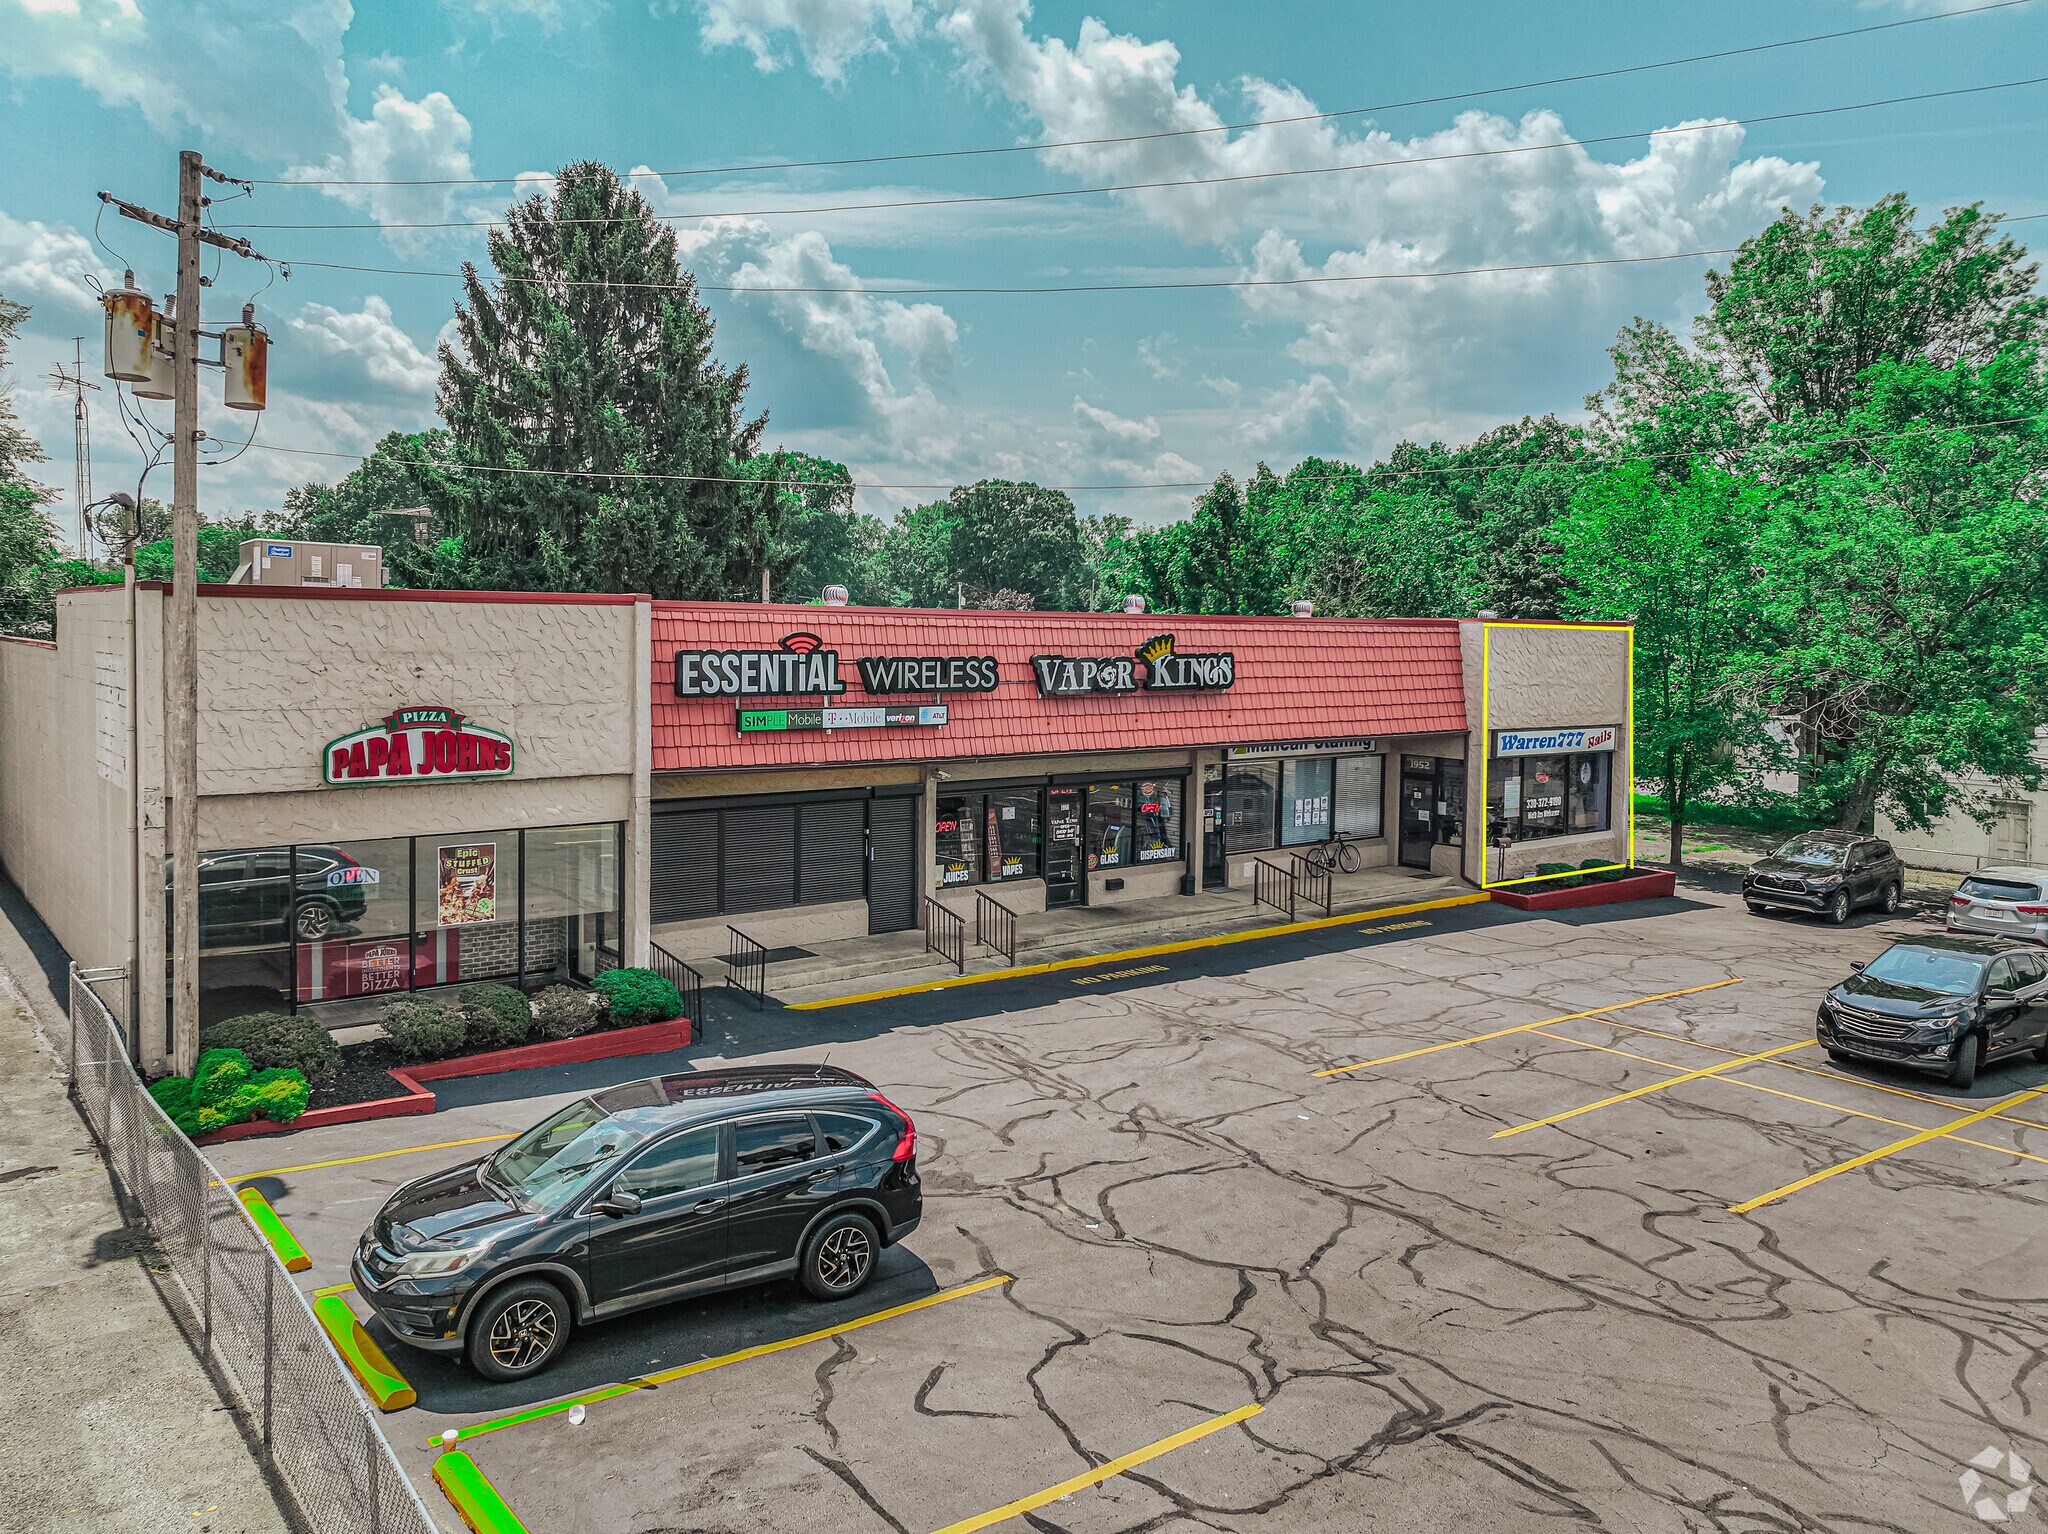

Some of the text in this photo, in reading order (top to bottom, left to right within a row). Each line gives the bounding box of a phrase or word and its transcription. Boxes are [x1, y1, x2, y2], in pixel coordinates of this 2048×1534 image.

[865, 660, 997, 690] WIRELESS
[1038, 654, 1233, 690] VAPOR KINGS
[402, 711, 447, 723] PIZZA
[744, 710, 822, 727] SIMPLE Mobile
[886, 713, 916, 723] verizon
[932, 712, 946, 720] AT&T
[1587, 730, 1612, 749] Nails
[332, 733, 413, 778] PAPA
[1410, 760, 1431, 770] 1952
[1141, 803, 1161, 813] OPEN
[936, 820, 958, 833] OPEN
[457, 849, 478, 859] Epic
[1100, 853, 1119, 865] GLASS
[1140, 847, 1176, 860] DISPENSARY
[446, 857, 490, 868] STUFFED
[330, 869, 375, 884] OPEN
[457, 867, 478, 875] Crust
[943, 870, 969, 883] JUICES
[1002, 863, 1024, 877] VAPES
[361, 956, 400, 968] BETTER
[361, 970, 400, 982] BETTER
[1070, 964, 1170, 986] NO PARKING
[361, 978, 400, 992] PIZZA
